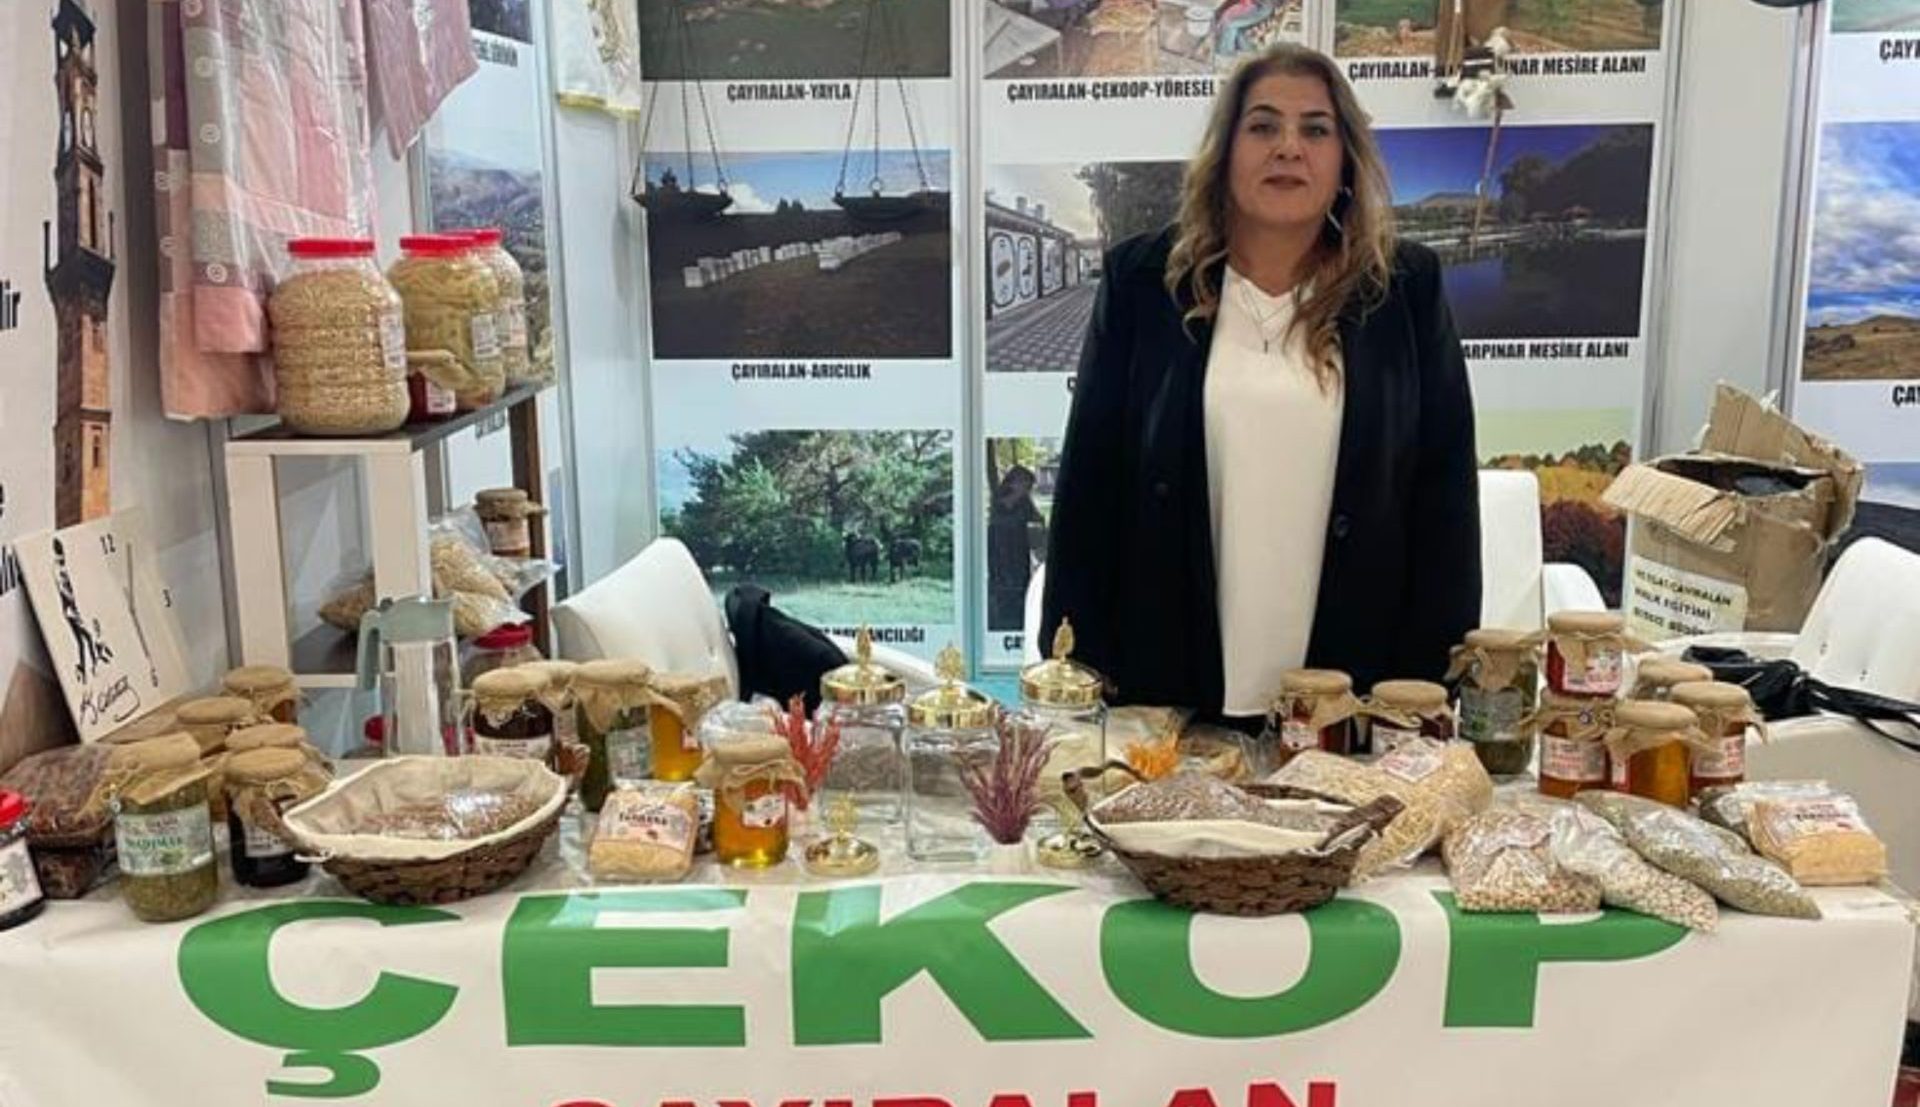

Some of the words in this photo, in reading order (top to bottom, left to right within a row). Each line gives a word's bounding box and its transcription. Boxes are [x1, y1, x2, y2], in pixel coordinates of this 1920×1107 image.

[1542, 55, 1598, 76] MESİRE
[1602, 56, 1646, 73] ALANI
[727, 83, 852, 103] ÇAYIRALAN-YAYLA
[1530, 340, 1582, 359] MESİRE
[1587, 341, 1628, 357] ALANI
[732, 363, 871, 381] ÇAYIRALAN-ARICILIK
[100, 533, 116, 555] 12
[178, 880, 1694, 1097] ÇEKOP
